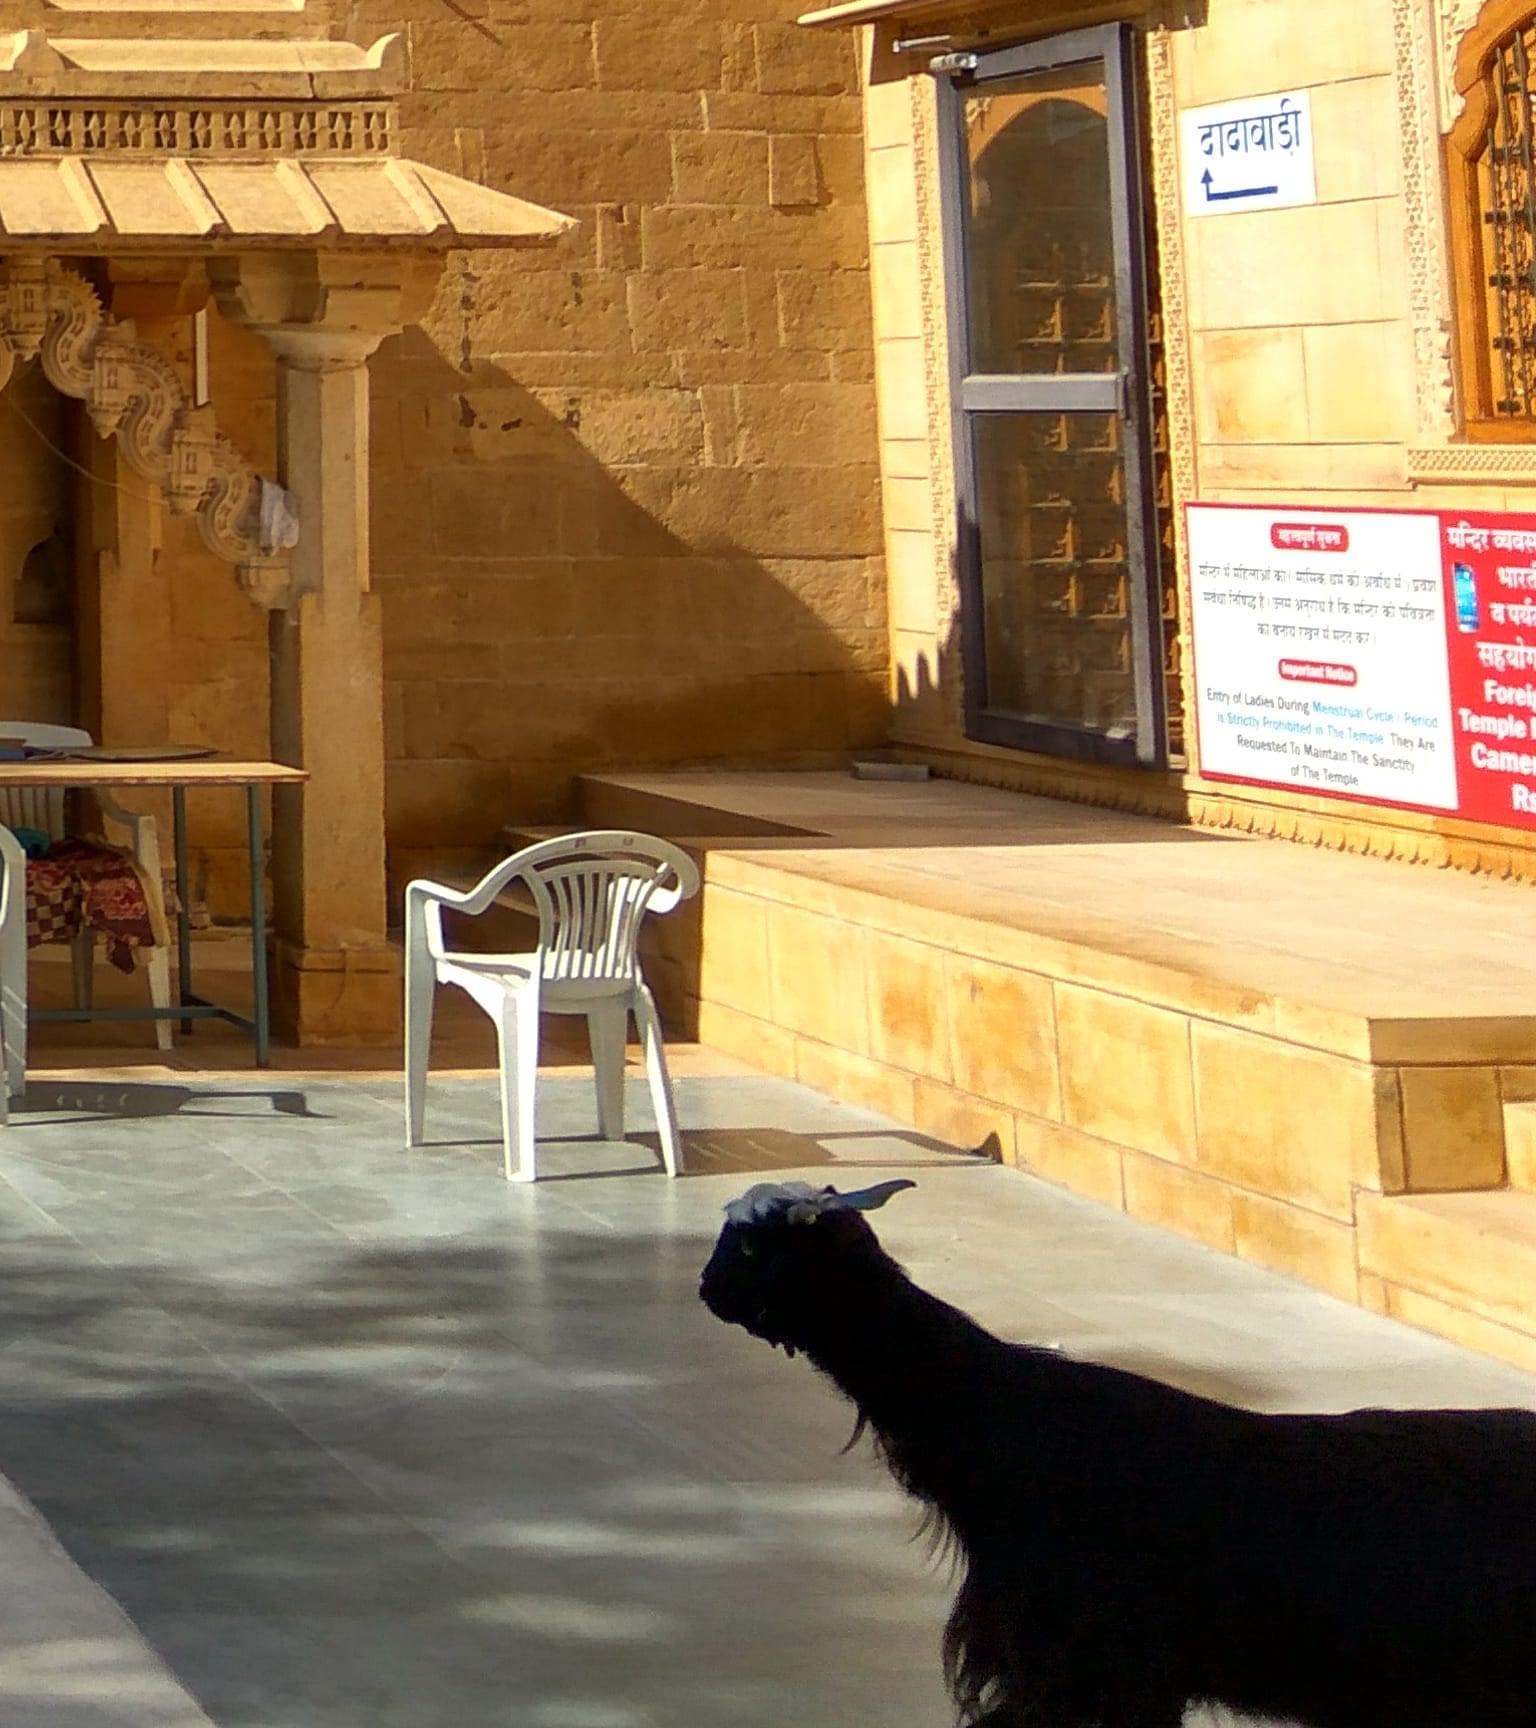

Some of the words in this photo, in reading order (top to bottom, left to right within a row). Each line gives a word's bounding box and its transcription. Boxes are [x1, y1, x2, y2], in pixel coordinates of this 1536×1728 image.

[1197, 98, 1302, 157] दादावाड़ी
[1207, 687, 1230, 705] Entry
[1233, 691, 1241, 704] of
[1244, 693, 1274, 708] Ladies
[1277, 696, 1310, 716] During
[1227, 711, 1259, 730] Strictly
[1263, 716, 1312, 734] Prohibited
[1327, 724, 1344, 739] The
[1390, 732, 1414, 751] They
[1418, 737, 1435, 752] Are
[1458, 707, 1527, 740] Temple
[1237, 734, 1287, 753] Requested
[1290, 741, 1300, 755] To
[1304, 743, 1347, 761] Maintain
[1351, 749, 1369, 765] The
[1372, 753, 1415, 774] Sanctity
[1291, 764, 1299, 777] of
[1302, 765, 1320, 780] The
[1323, 768, 1358, 786] Temple
